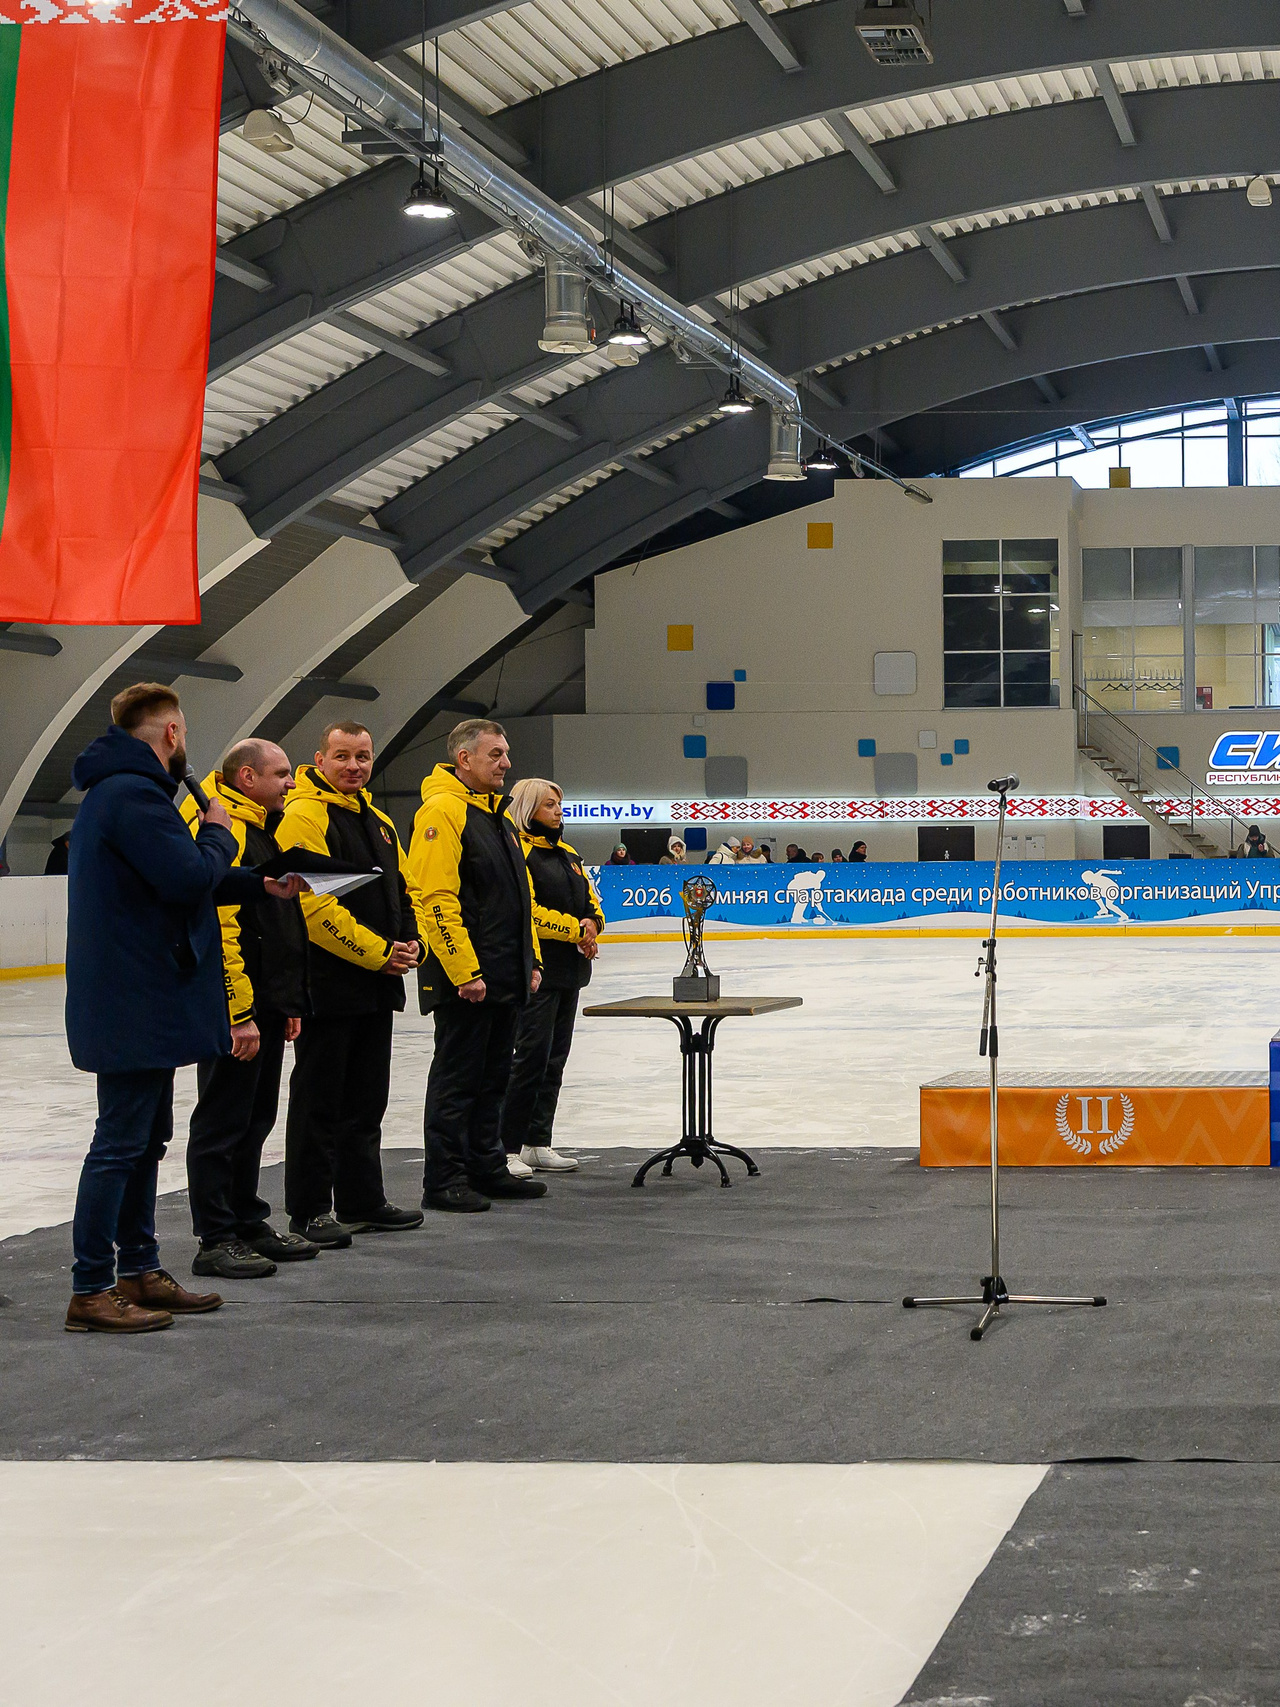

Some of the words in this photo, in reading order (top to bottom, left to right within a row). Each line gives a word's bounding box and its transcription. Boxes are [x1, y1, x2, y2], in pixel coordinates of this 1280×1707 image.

[562, 803, 654, 820] silichy.by
[622, 887, 672, 907] 2026
[711, 889, 769, 905] мняя
[774, 888, 906, 907] спартакиада
[911, 886, 972, 906] среди
[1105, 880, 1241, 905] организаций
[321, 919, 367, 957] BELARUS
[432, 905, 457, 956] BELARUS
[532, 916, 571, 934] ELARUS
[1076, 1096, 1114, 1134] II
